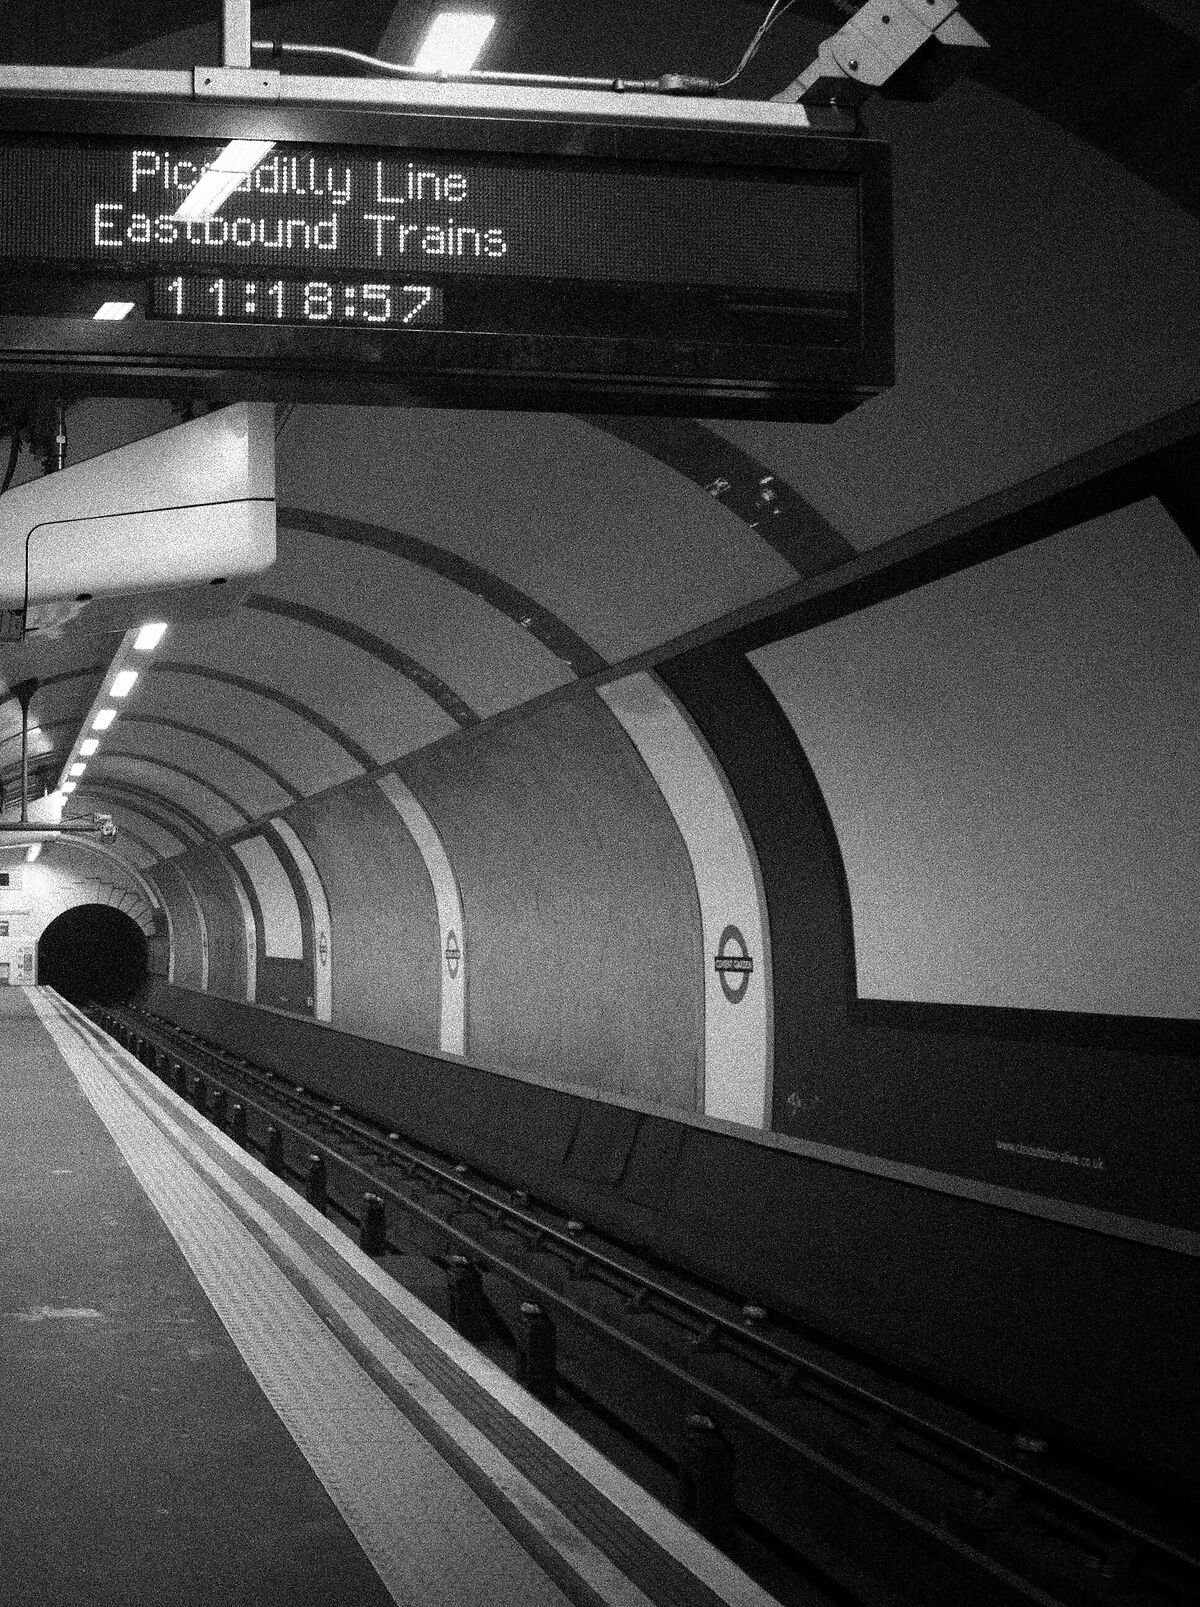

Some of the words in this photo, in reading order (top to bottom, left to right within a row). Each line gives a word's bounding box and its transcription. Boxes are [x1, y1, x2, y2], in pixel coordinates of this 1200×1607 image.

[131, 150, 351, 205] Picdilly
[376, 161, 467, 203] Line
[94, 203, 337, 250] Eastbound
[363, 213, 506, 257] Trains
[167, 276, 431, 323] 11:18:57
